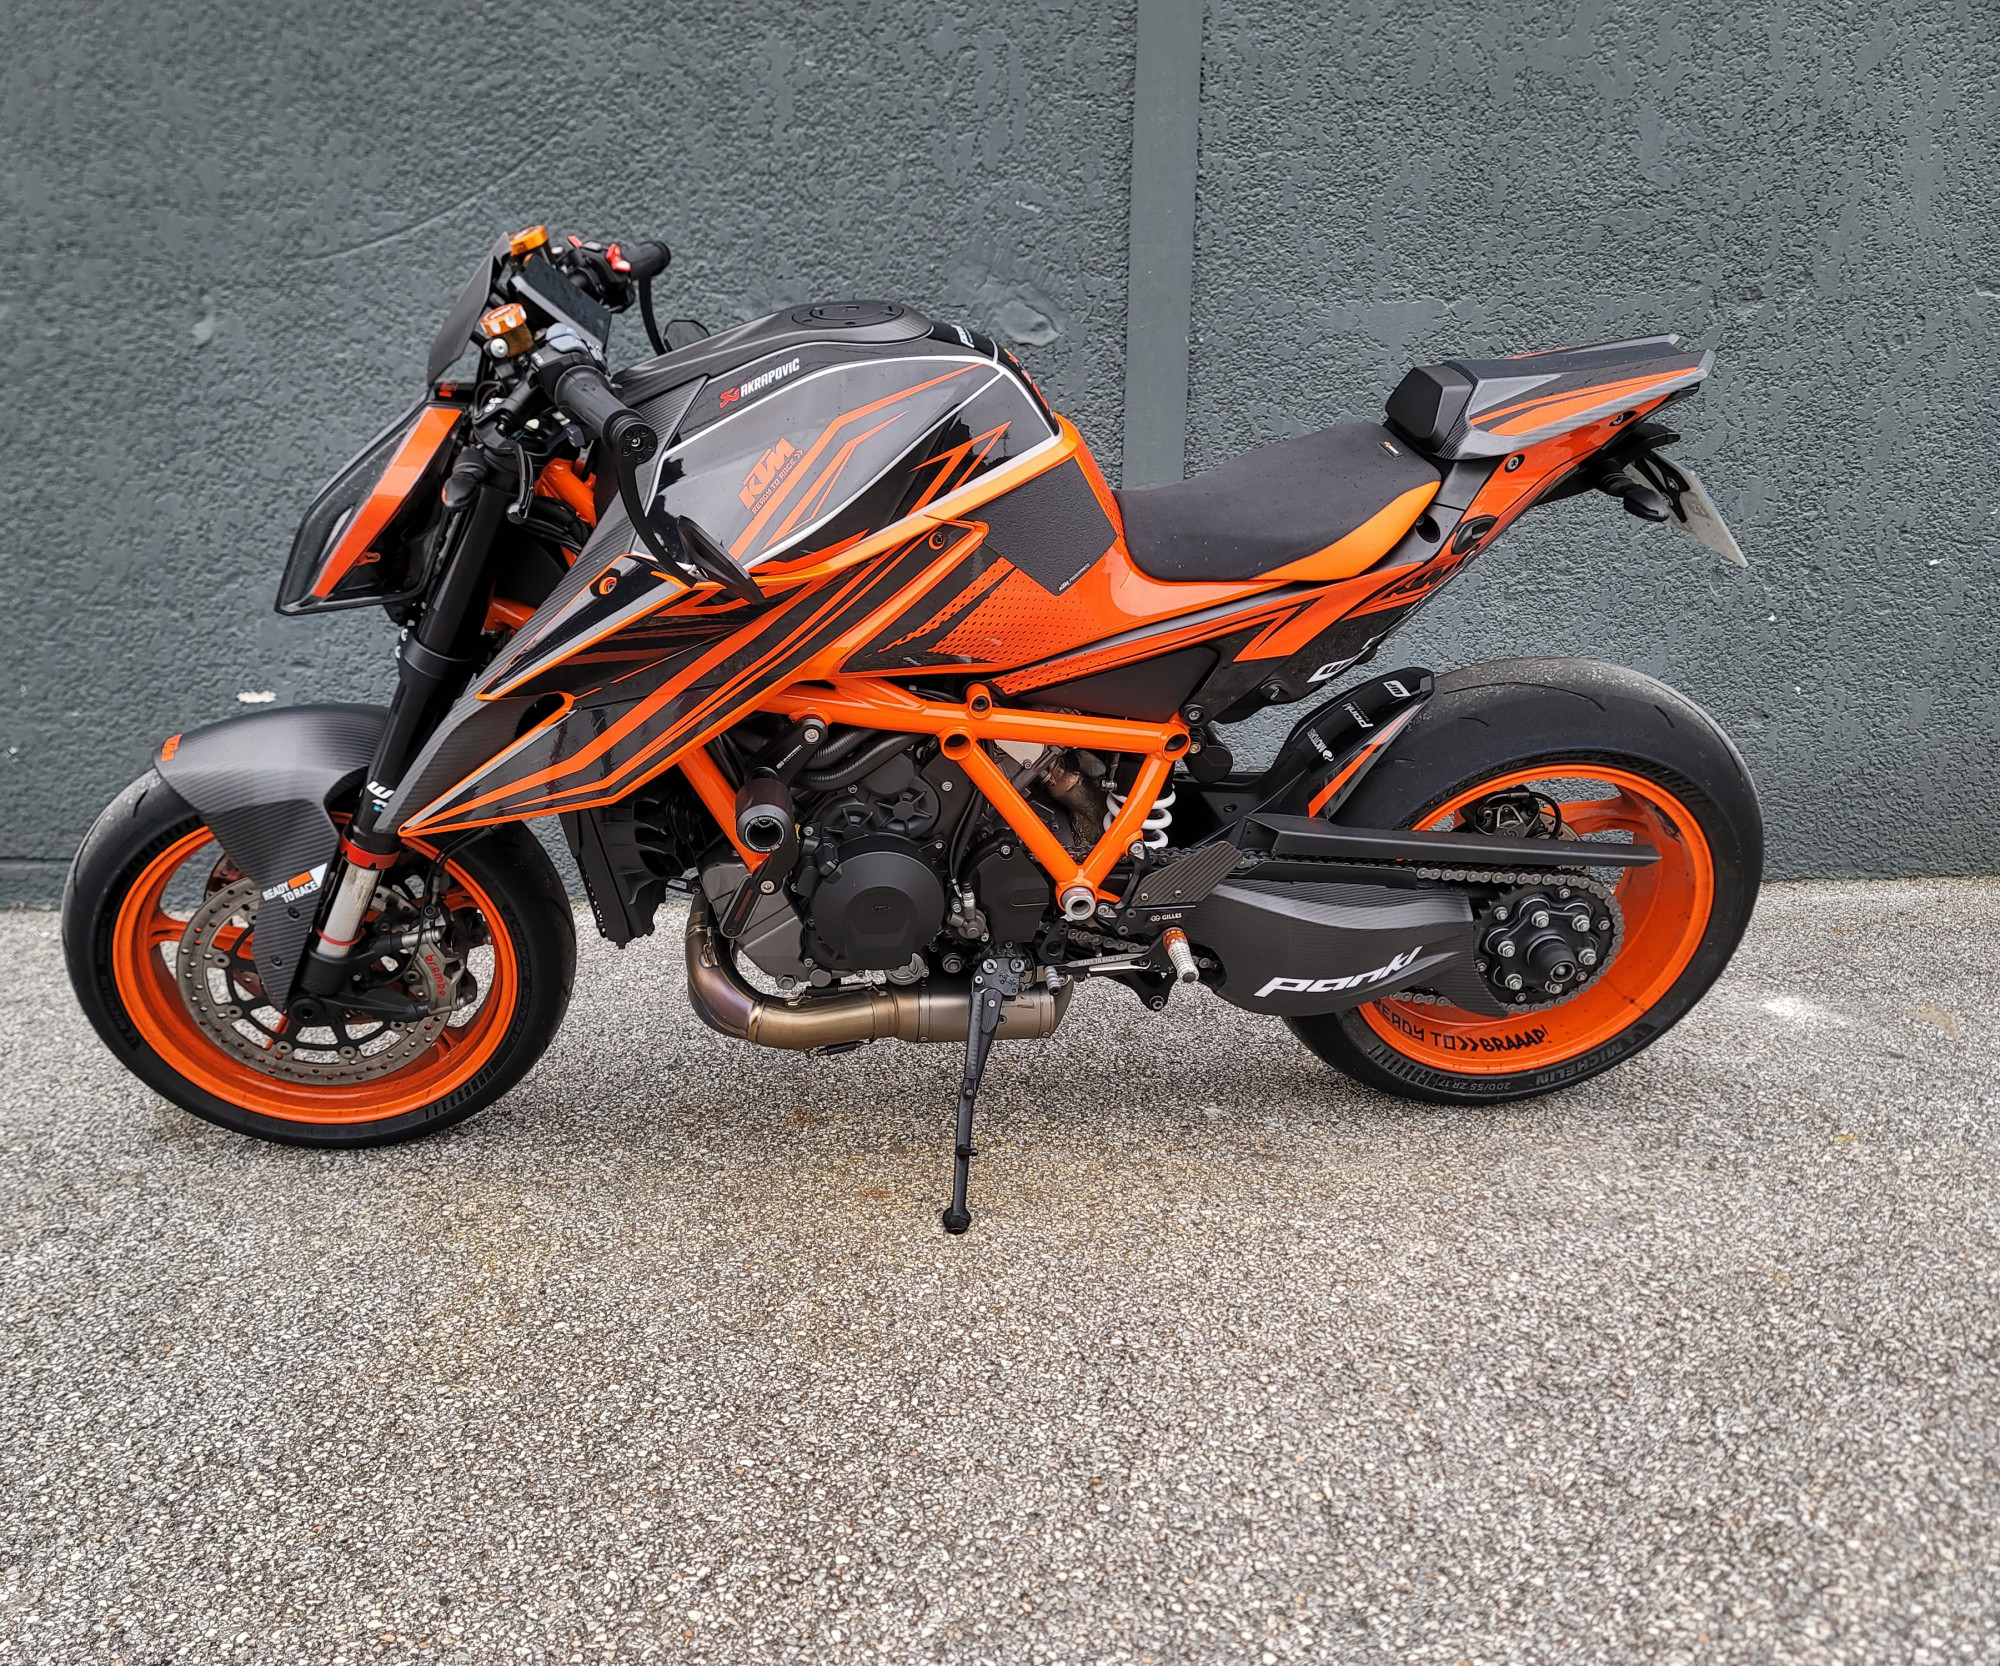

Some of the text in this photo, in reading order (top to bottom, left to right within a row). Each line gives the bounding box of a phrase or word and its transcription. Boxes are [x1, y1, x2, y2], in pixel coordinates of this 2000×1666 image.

[738, 437, 796, 510] KTM
[751, 457, 796, 515] READY TO RACE
[261, 881, 290, 902] READY
[281, 880, 319, 904] TO RACE
[1161, 912, 1182, 921] GILLES
[424, 954, 448, 997] brembo
[1438, 1041, 1623, 1092] MICHELIN 200/55 ZR 17
